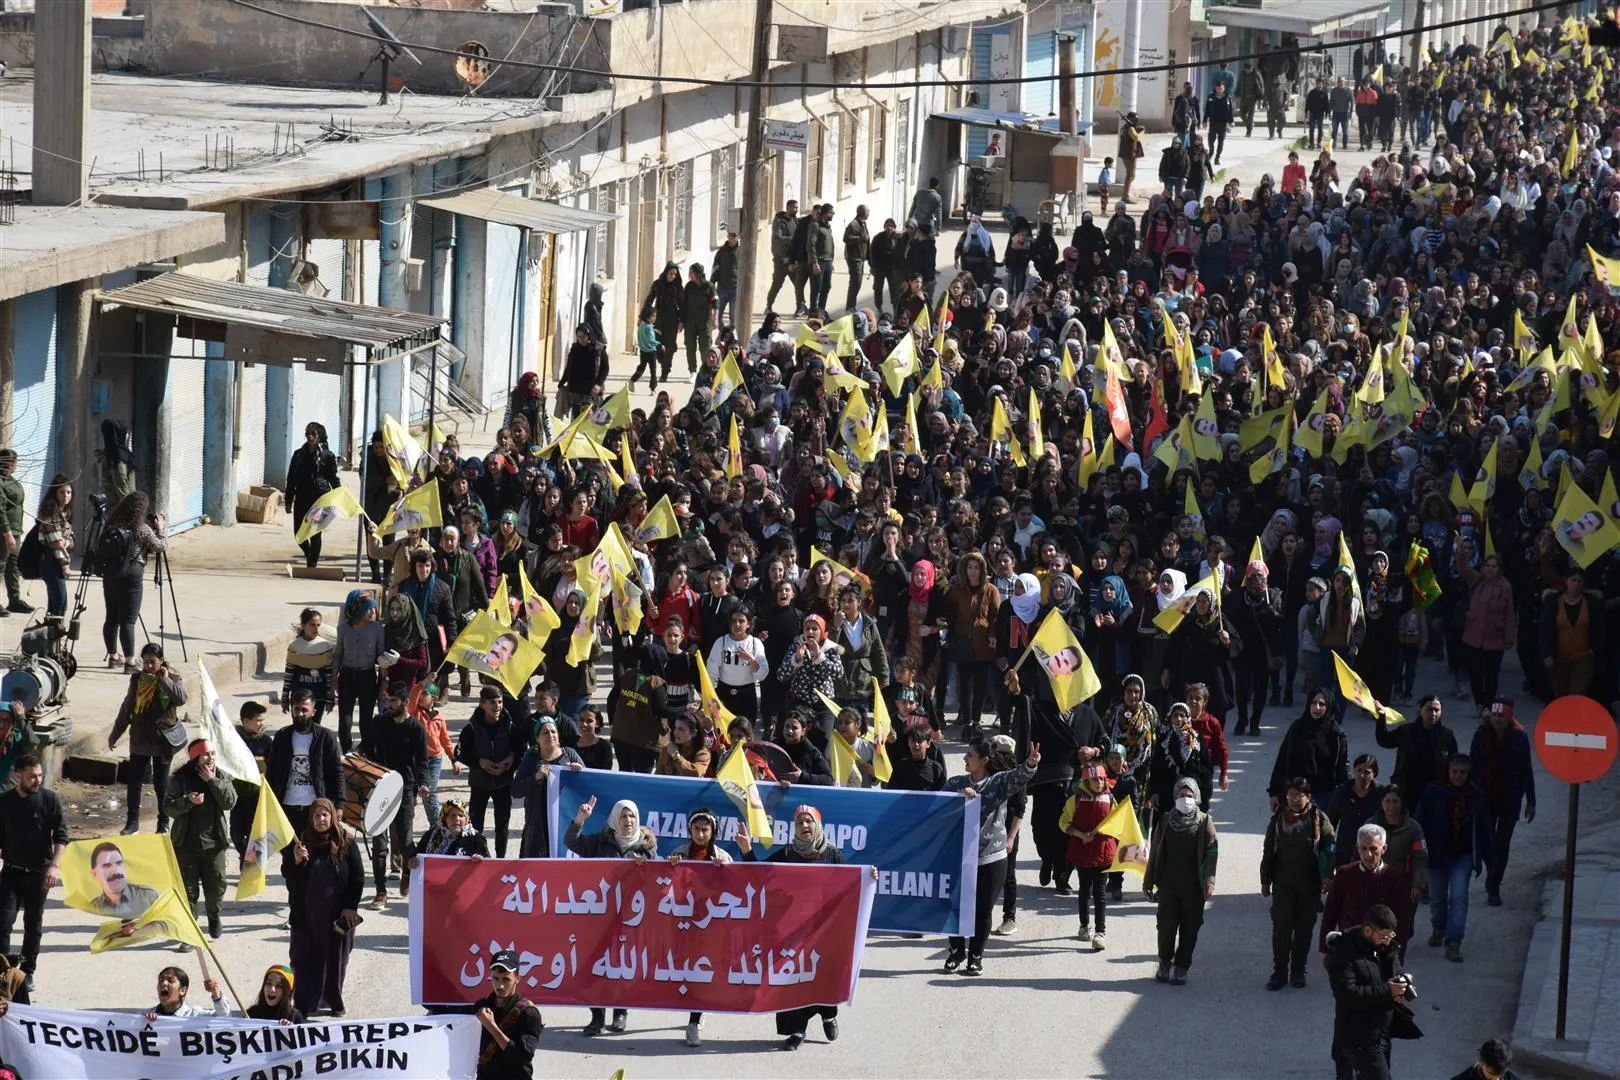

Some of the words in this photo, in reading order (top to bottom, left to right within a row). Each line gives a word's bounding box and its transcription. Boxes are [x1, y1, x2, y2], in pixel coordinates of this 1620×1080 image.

[824, 823, 868, 851] APO
[500, 873, 646, 928] والعدالة
[656, 875, 767, 930] الحرية
[876, 870, 934, 898] ELAN
[939, 873, 951, 899] E
[727, 942, 821, 987] للقائد
[20, 1019, 161, 1057] TECRÎDÊ
